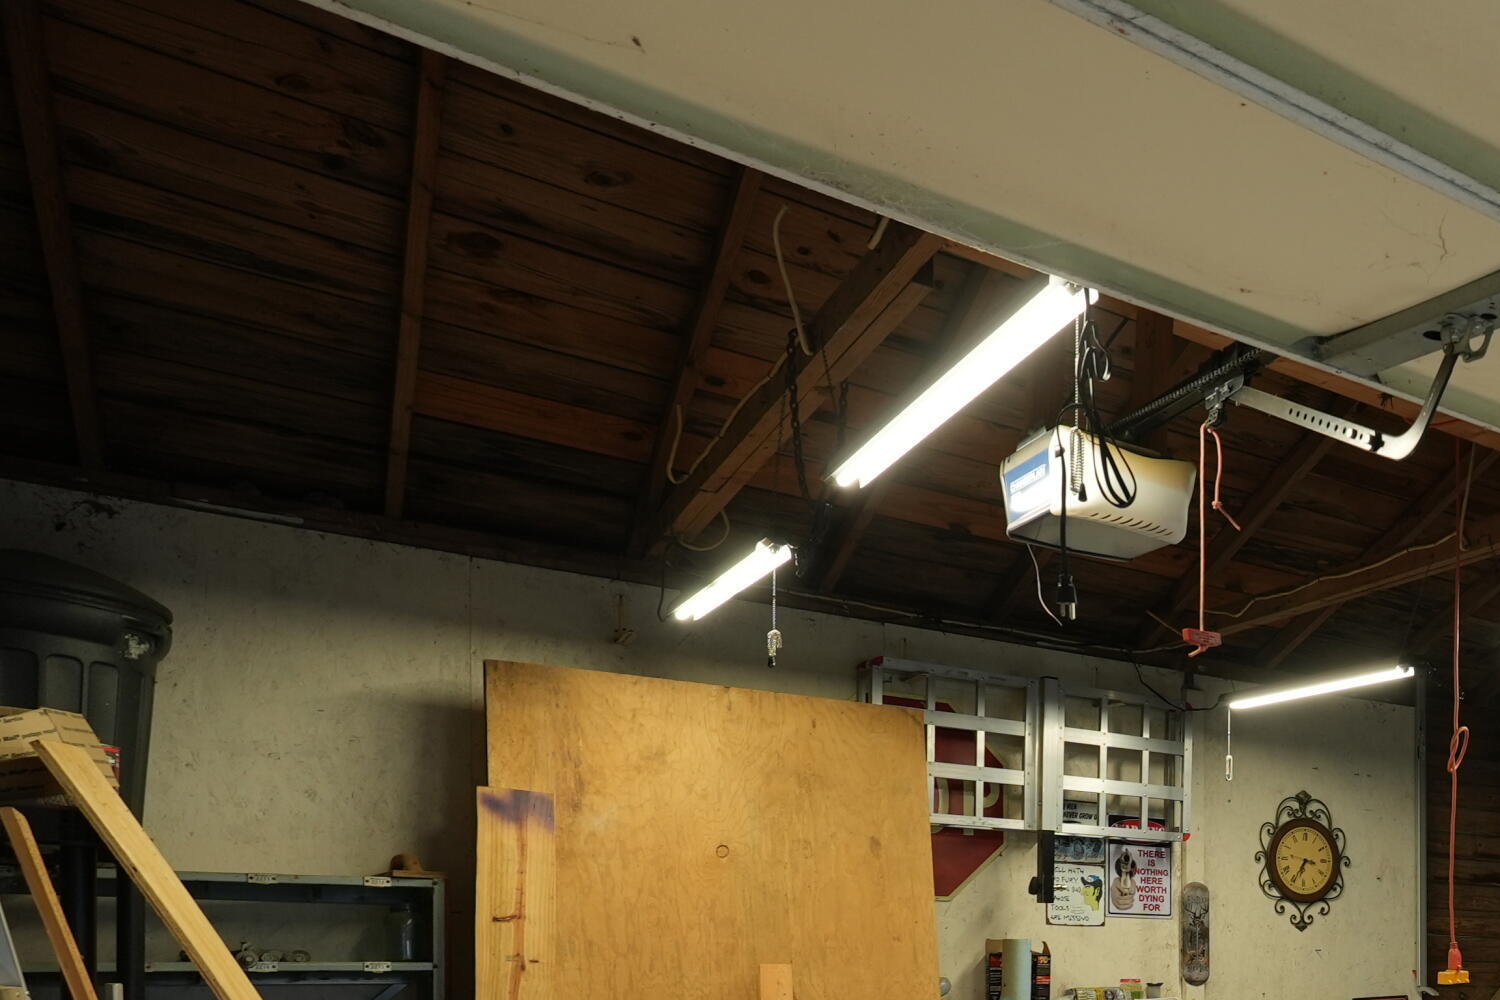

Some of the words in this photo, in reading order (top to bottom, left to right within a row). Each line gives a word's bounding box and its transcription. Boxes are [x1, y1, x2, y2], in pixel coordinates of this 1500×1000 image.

[1137, 849, 1166, 859] THERE
[1147, 859, 1156, 867] IS
[1135, 868, 1169, 877] NOTHING
[1140, 877, 1163, 885] HERE
[1136, 885, 1167, 894] WORTH
[1139, 895, 1165, 903] DYING
[1143, 904, 1161, 912] FOR
